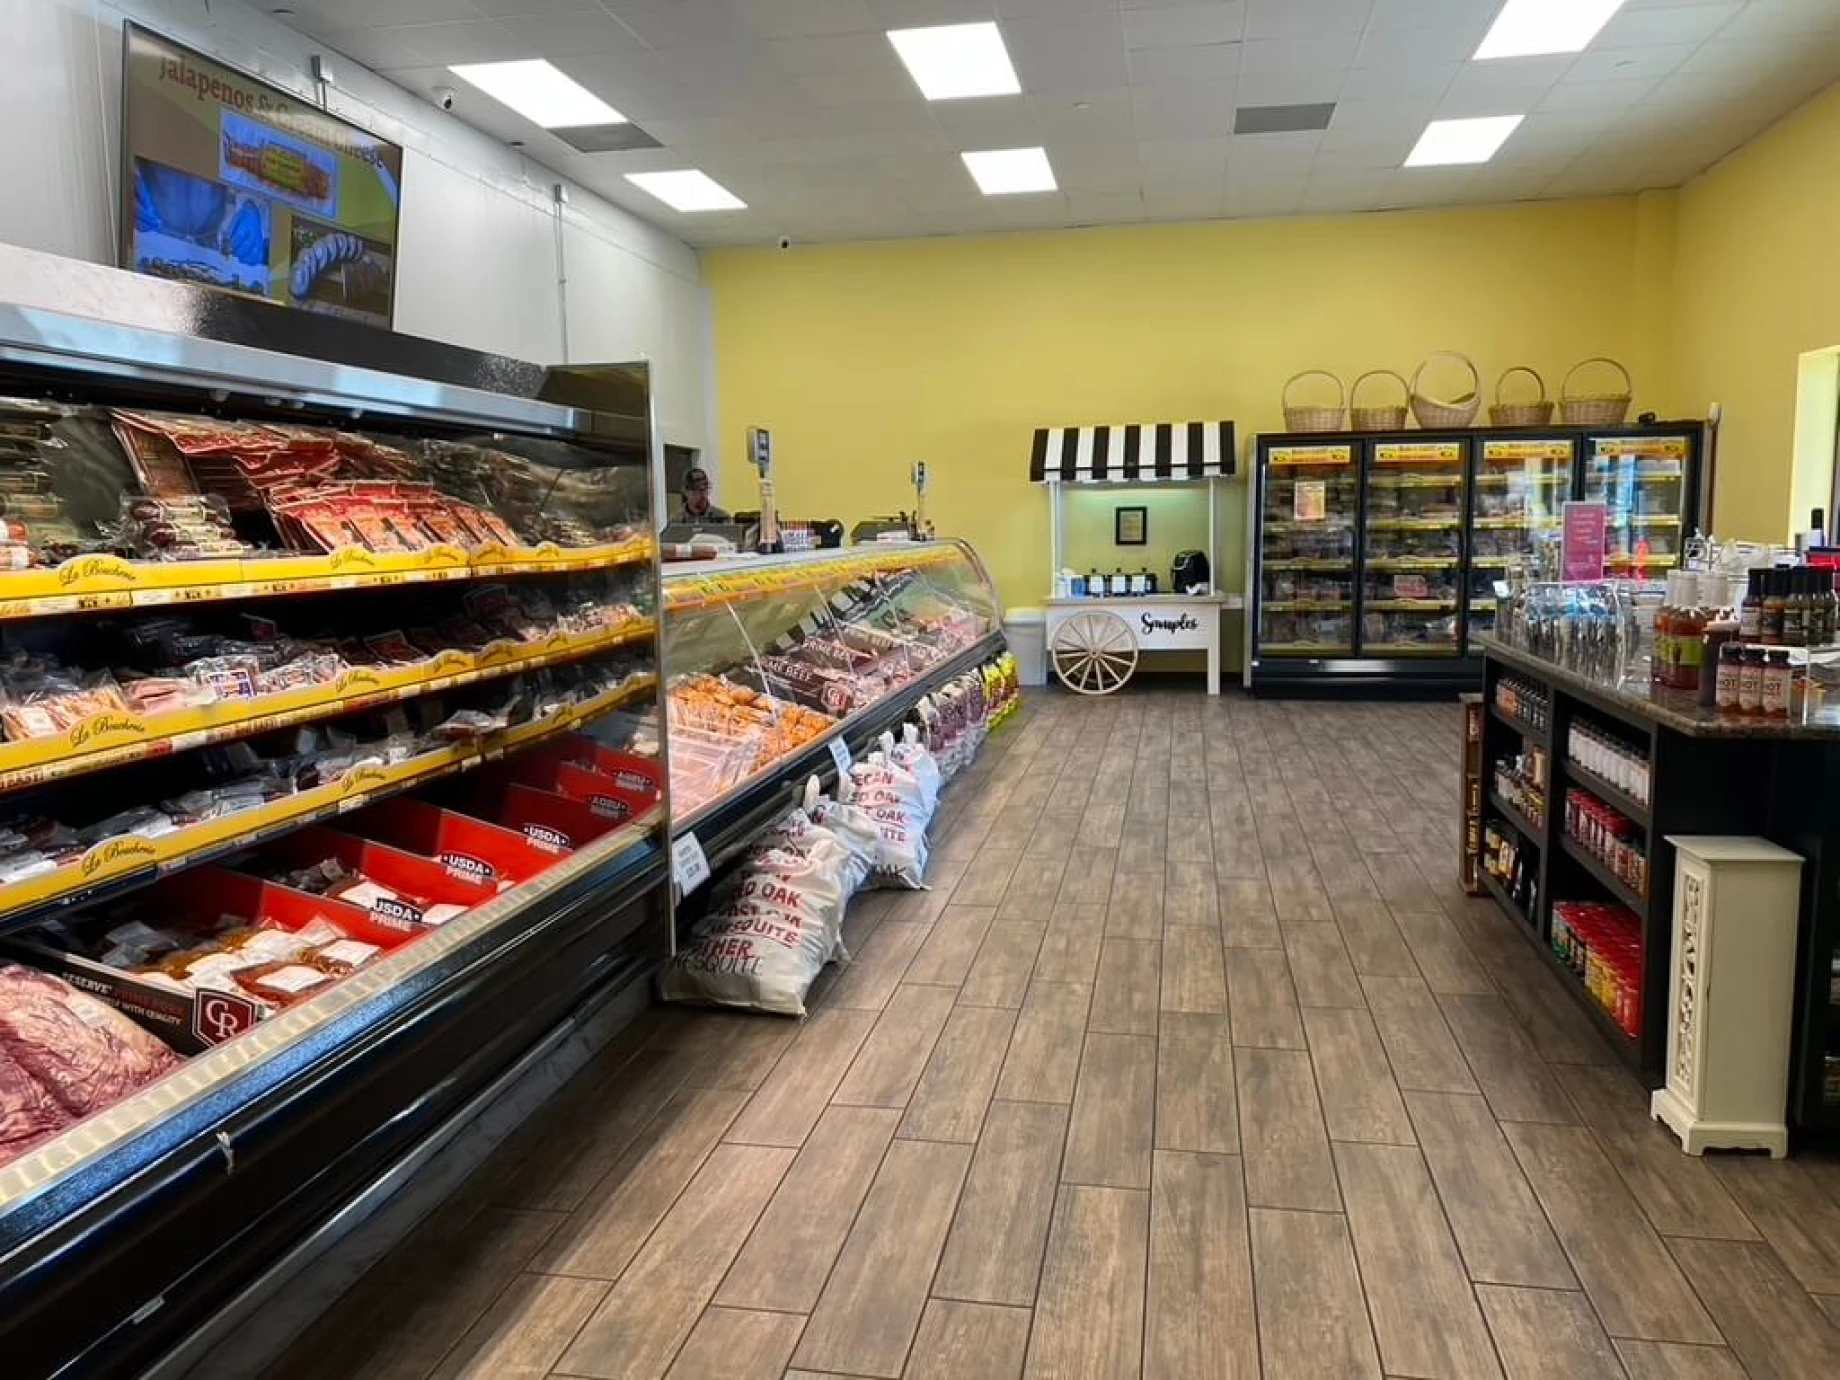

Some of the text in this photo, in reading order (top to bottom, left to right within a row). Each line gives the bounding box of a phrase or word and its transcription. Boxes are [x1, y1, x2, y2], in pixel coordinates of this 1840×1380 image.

[1141, 612, 1198, 635] Samples
[852, 771, 894, 786] ECAN
[877, 809, 906, 823] OAK
[529, 826, 561, 845] USDA
[448, 854, 485, 876] USDA
[761, 882, 803, 909] OAK
[698, 937, 755, 958] THER
[121, 1002, 146, 1016] WITH
[145, 1009, 182, 1026] QUALITY
